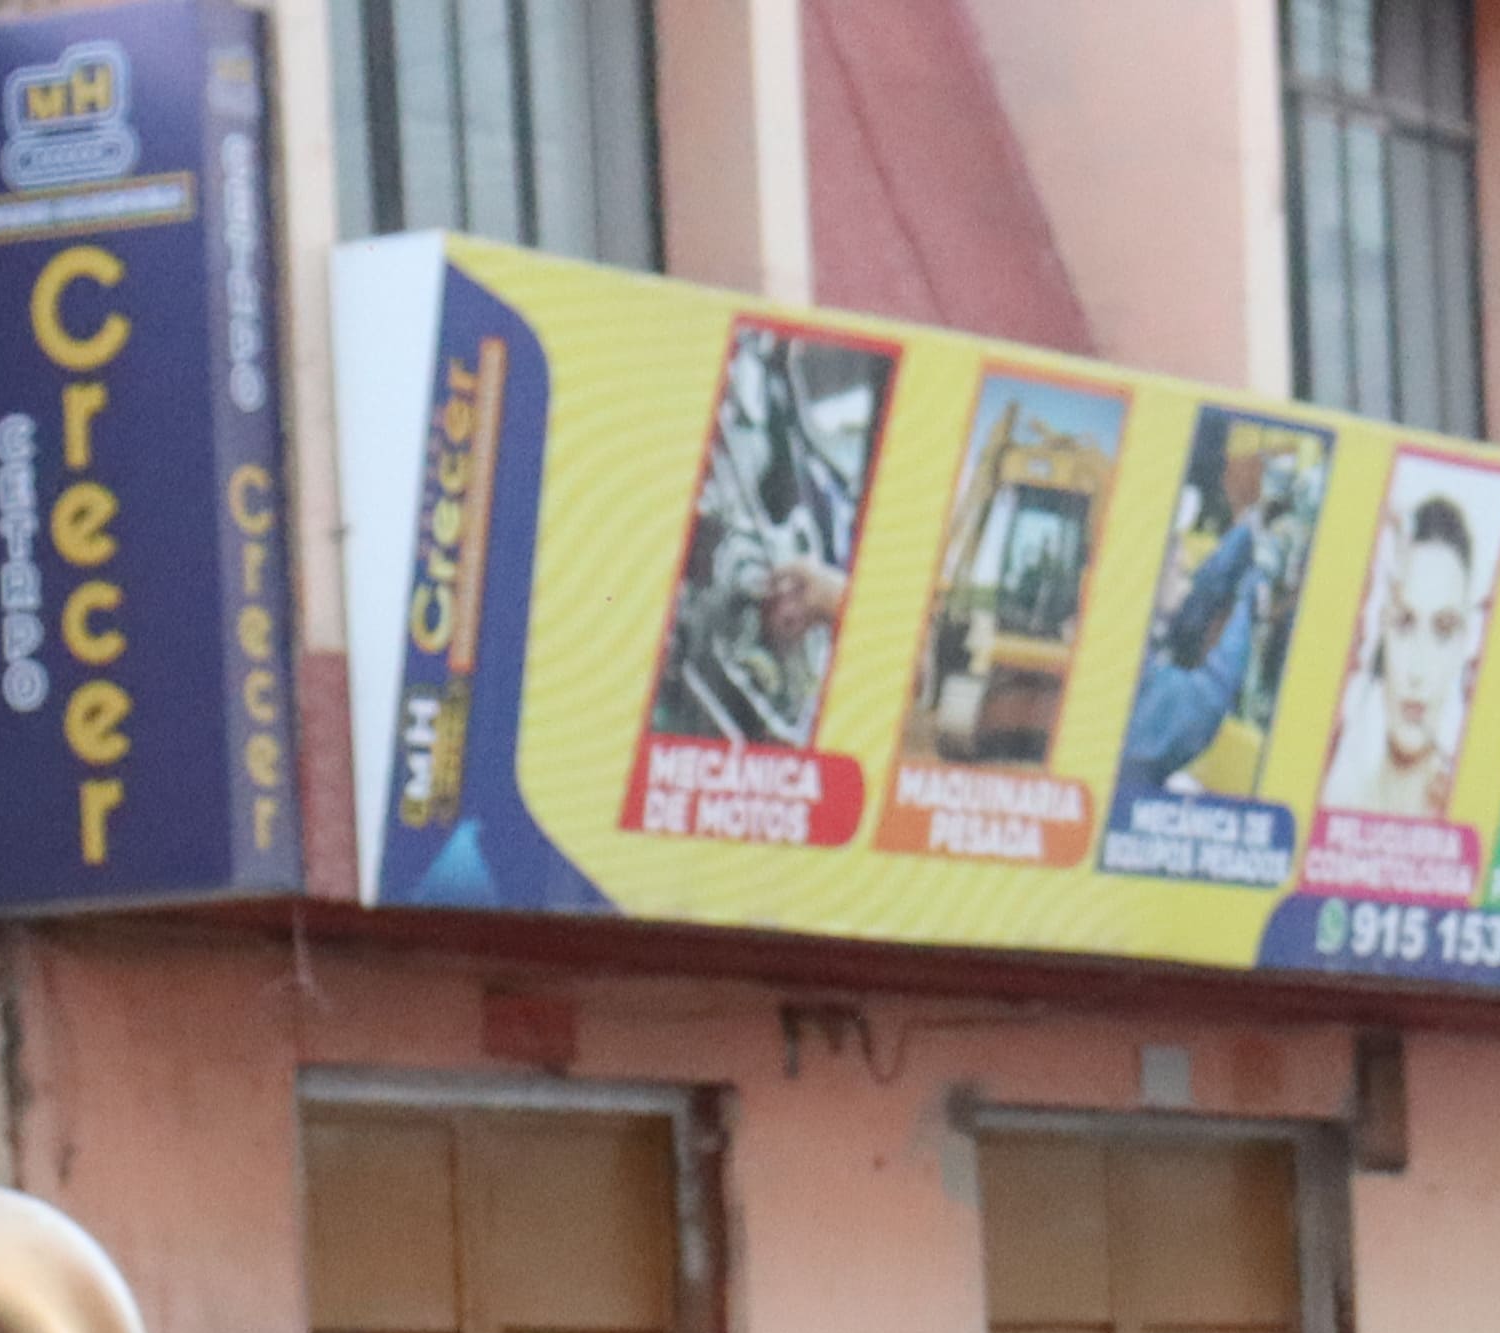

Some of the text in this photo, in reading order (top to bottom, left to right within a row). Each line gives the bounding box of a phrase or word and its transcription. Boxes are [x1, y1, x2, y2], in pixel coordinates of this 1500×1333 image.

[411, 359, 479, 653] Crecer
[31, 246, 133, 864] Crecer
[643, 790, 810, 844] DE MOTOS
[899, 766, 1084, 820] MAQUINARIA
[928, 813, 1043, 858] PESADA
[1352, 904, 1426, 958] 915
